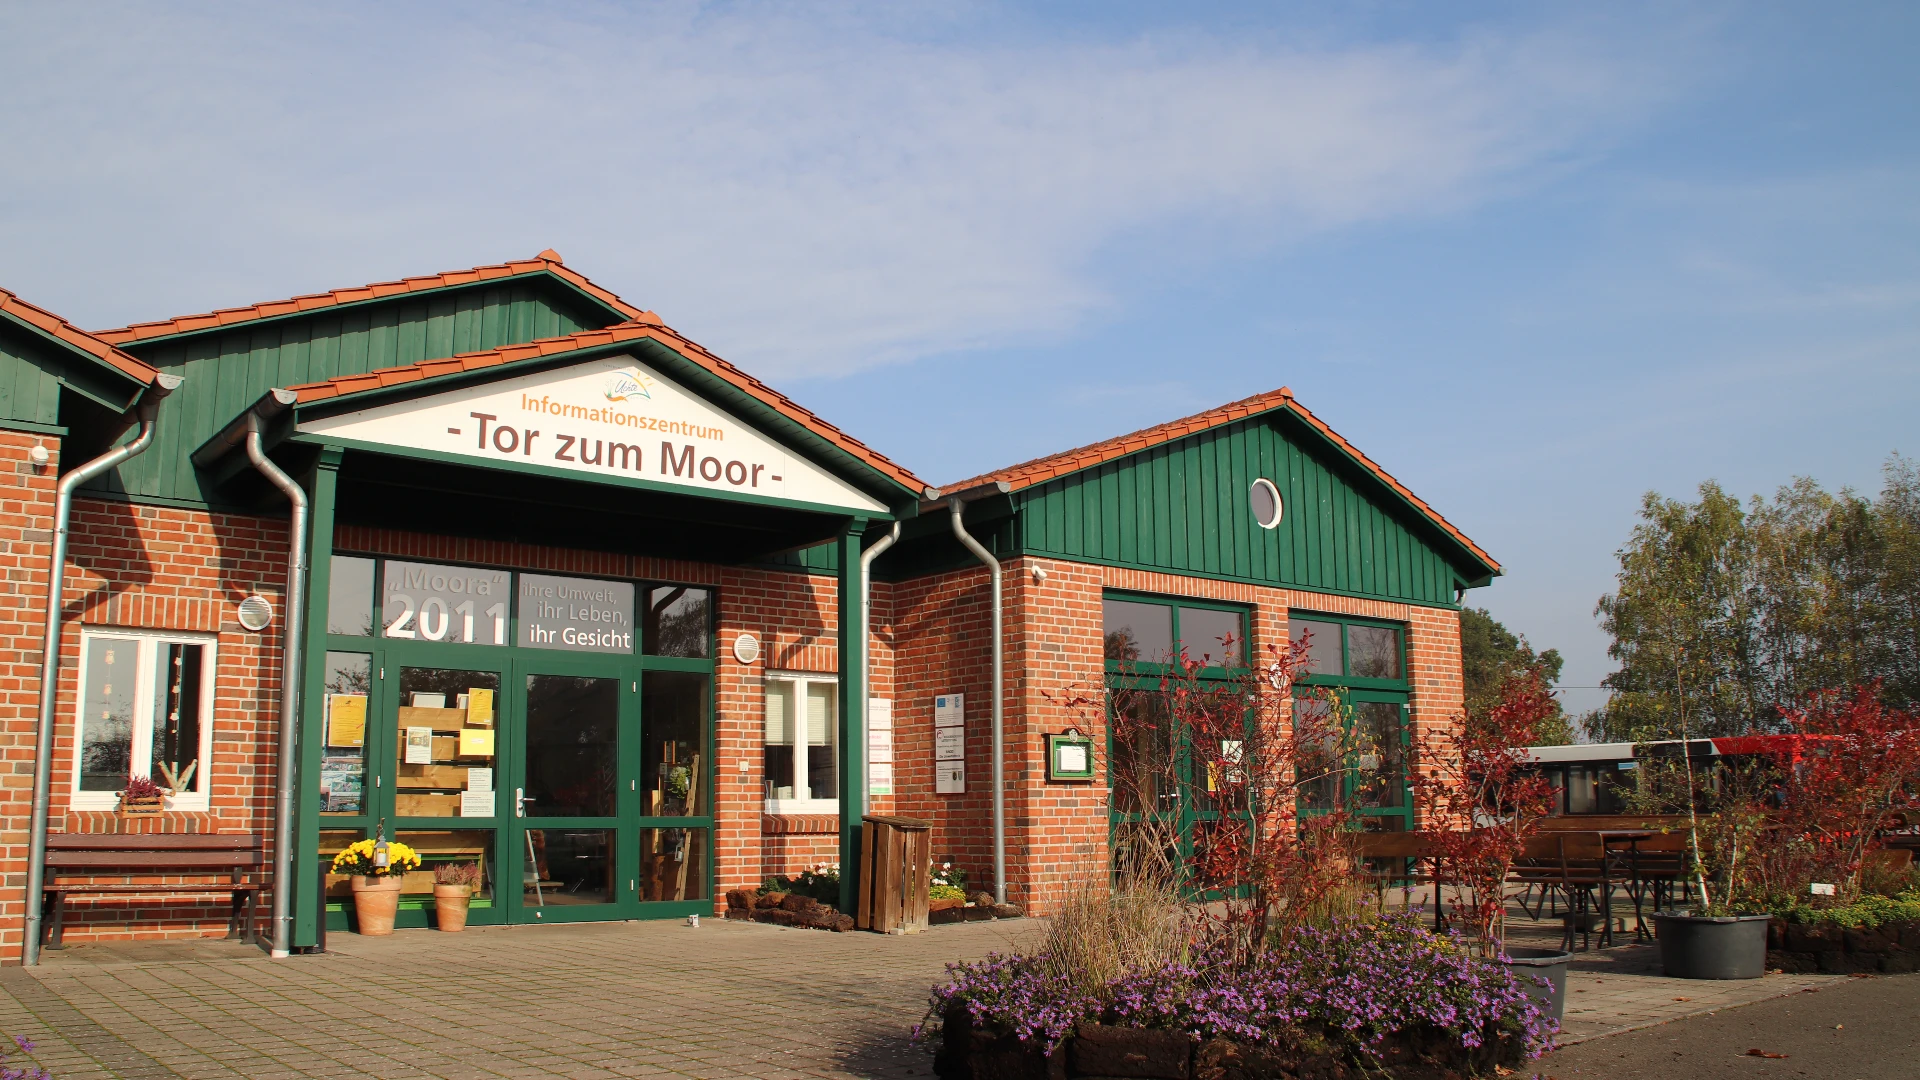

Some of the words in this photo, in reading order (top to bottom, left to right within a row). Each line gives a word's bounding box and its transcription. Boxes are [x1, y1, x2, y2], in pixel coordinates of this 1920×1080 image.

[521, 393, 724, 441] Informationszentrum
[554, 433, 642, 472] zum
[523, 582, 553, 598] ihre
[556, 585, 617, 605] Umwelt,
[386, 593, 505, 645] 2011
[538, 601, 564, 619] ihr
[568, 603, 627, 627] Leben,
[529, 624, 557, 644] ihr
[562, 627, 631, 649] Gesicht
